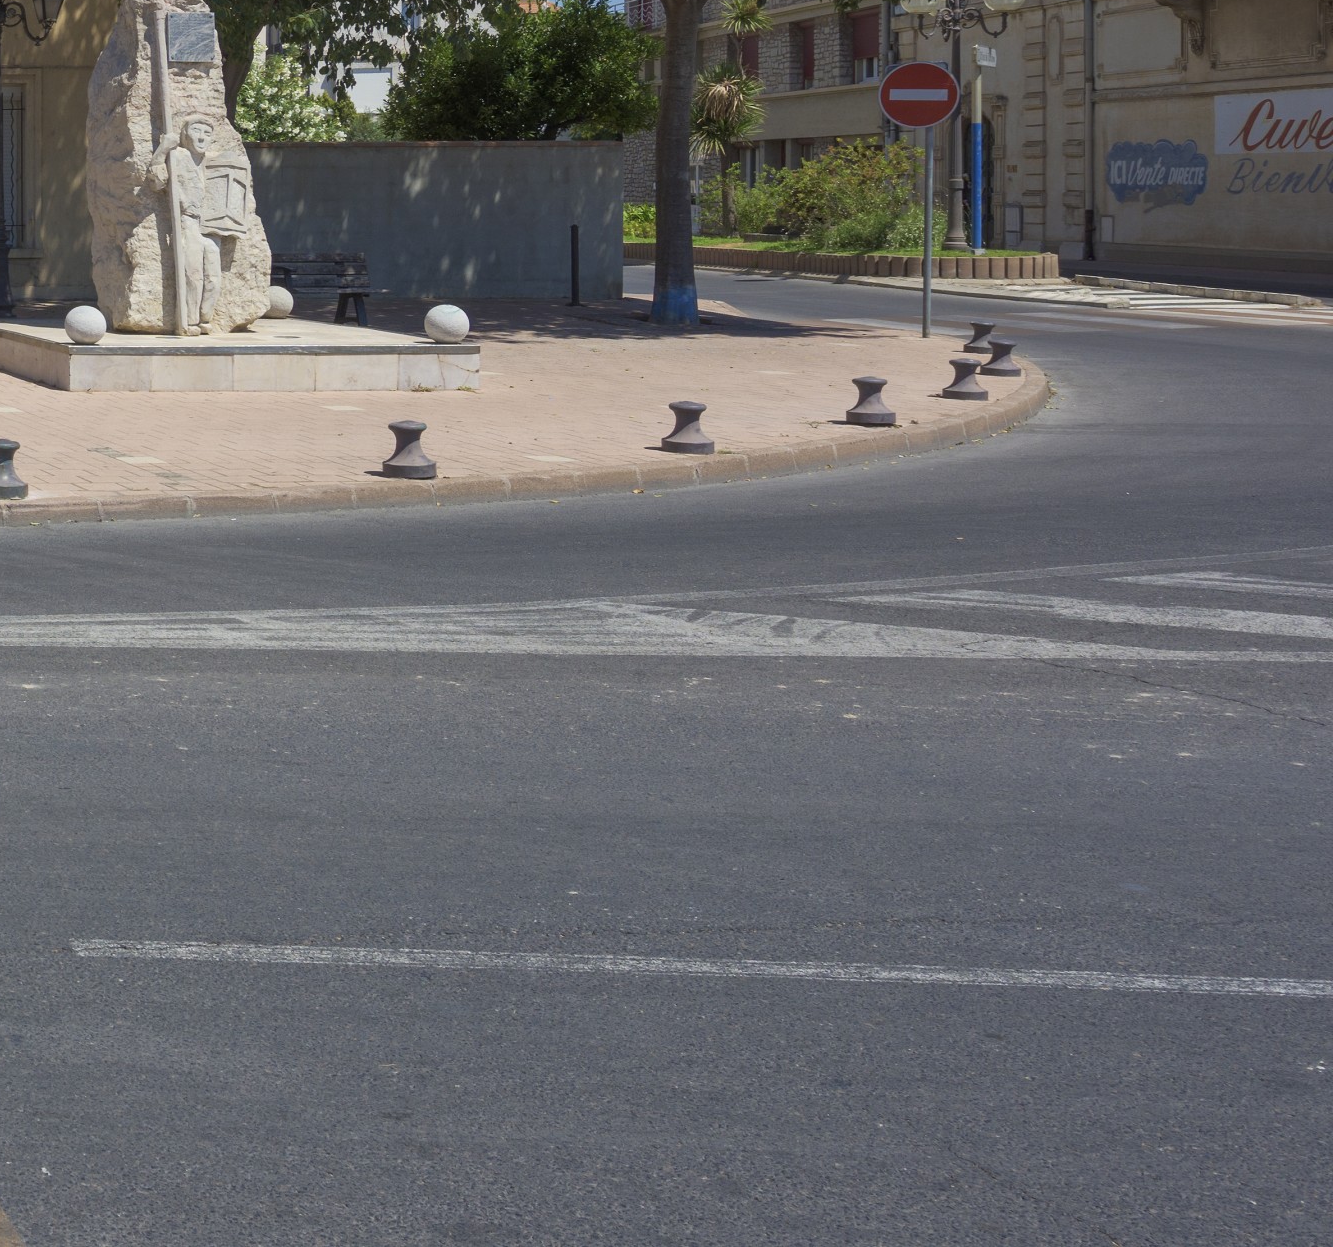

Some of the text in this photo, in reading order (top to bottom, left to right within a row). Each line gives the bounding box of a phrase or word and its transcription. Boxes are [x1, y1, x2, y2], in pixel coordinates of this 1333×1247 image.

[1110, 157, 1205, 186] ICI Vente DIRECTE
[1226, 157, 1333, 194] Bienv
